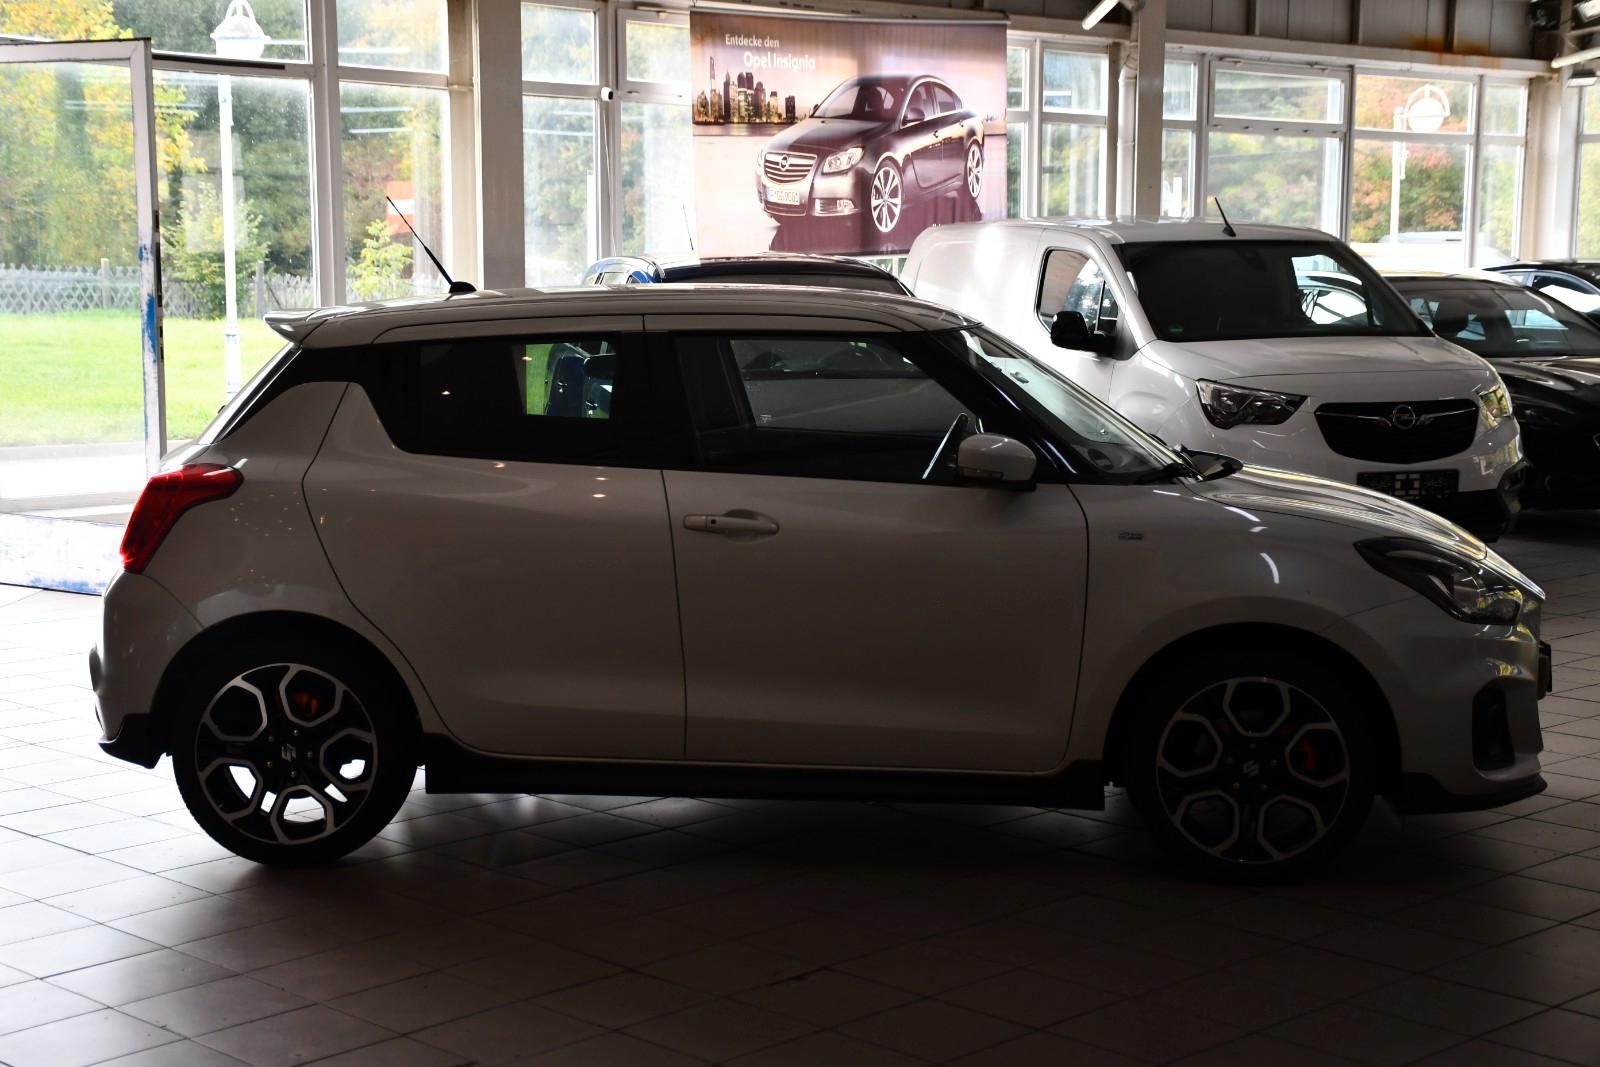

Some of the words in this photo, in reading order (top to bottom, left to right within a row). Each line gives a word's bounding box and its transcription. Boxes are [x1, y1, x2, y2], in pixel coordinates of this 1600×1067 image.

[725, 33, 762, 47] Entdecke
[764, 36, 780, 48] den
[743, 51, 771, 70] Opel
[773, 53, 816, 71] Insignia
